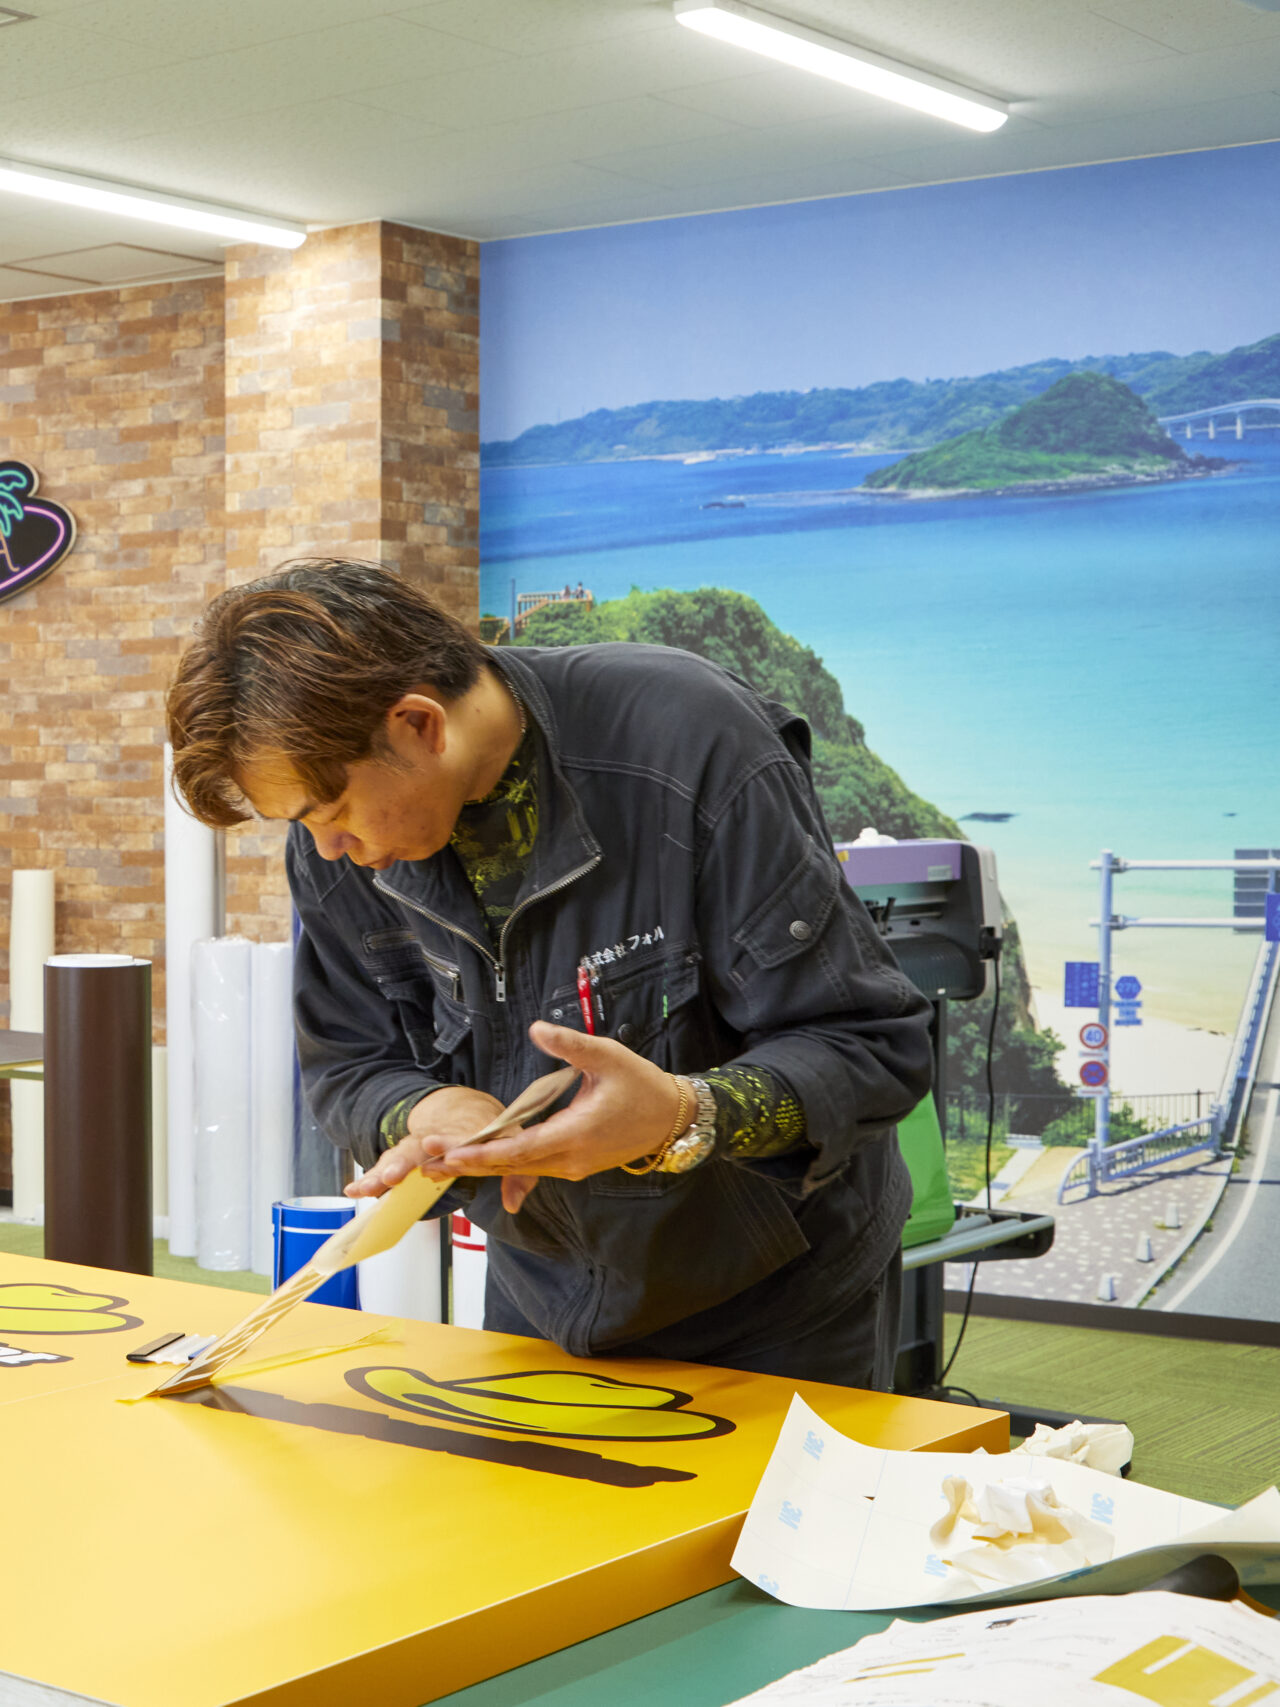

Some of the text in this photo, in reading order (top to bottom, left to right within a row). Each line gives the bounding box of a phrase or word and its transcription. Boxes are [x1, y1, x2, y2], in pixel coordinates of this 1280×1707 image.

[1085, 1029, 1103, 1043] 40
[803, 1430, 824, 1461] 3M
[778, 1500, 803, 1530] 3M
[1090, 1493, 1114, 1525] 3M
